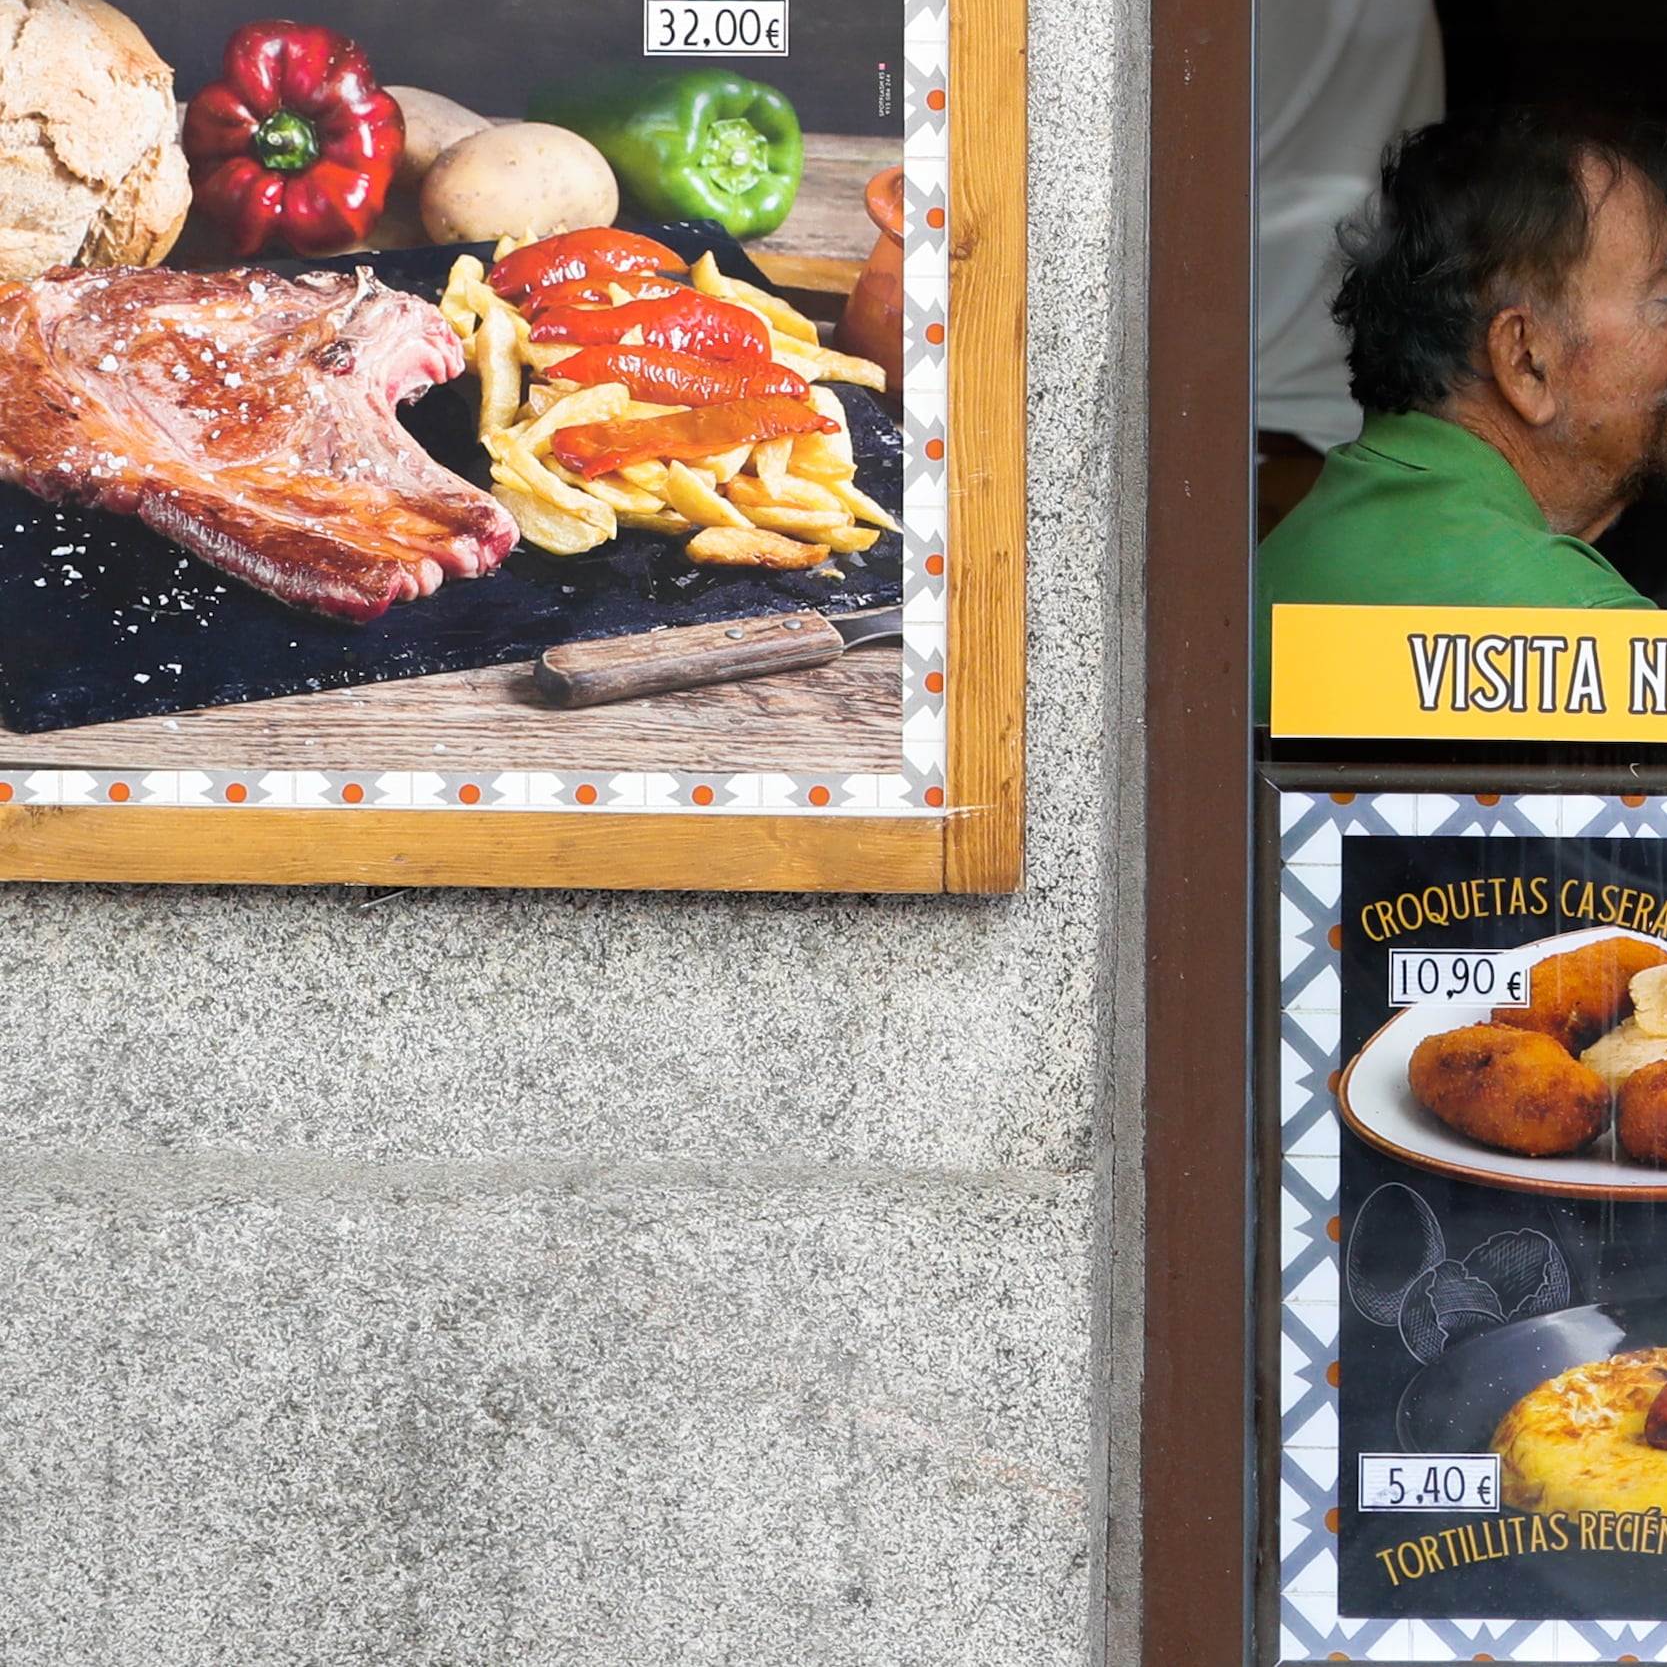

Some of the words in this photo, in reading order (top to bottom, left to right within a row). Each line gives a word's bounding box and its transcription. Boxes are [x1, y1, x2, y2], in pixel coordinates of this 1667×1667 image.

[1407, 633, 1604, 714] VISITA
[1360, 876, 1549, 943] CROQUETAS
[1376, 1512, 1569, 1587] TORTILLITAS
